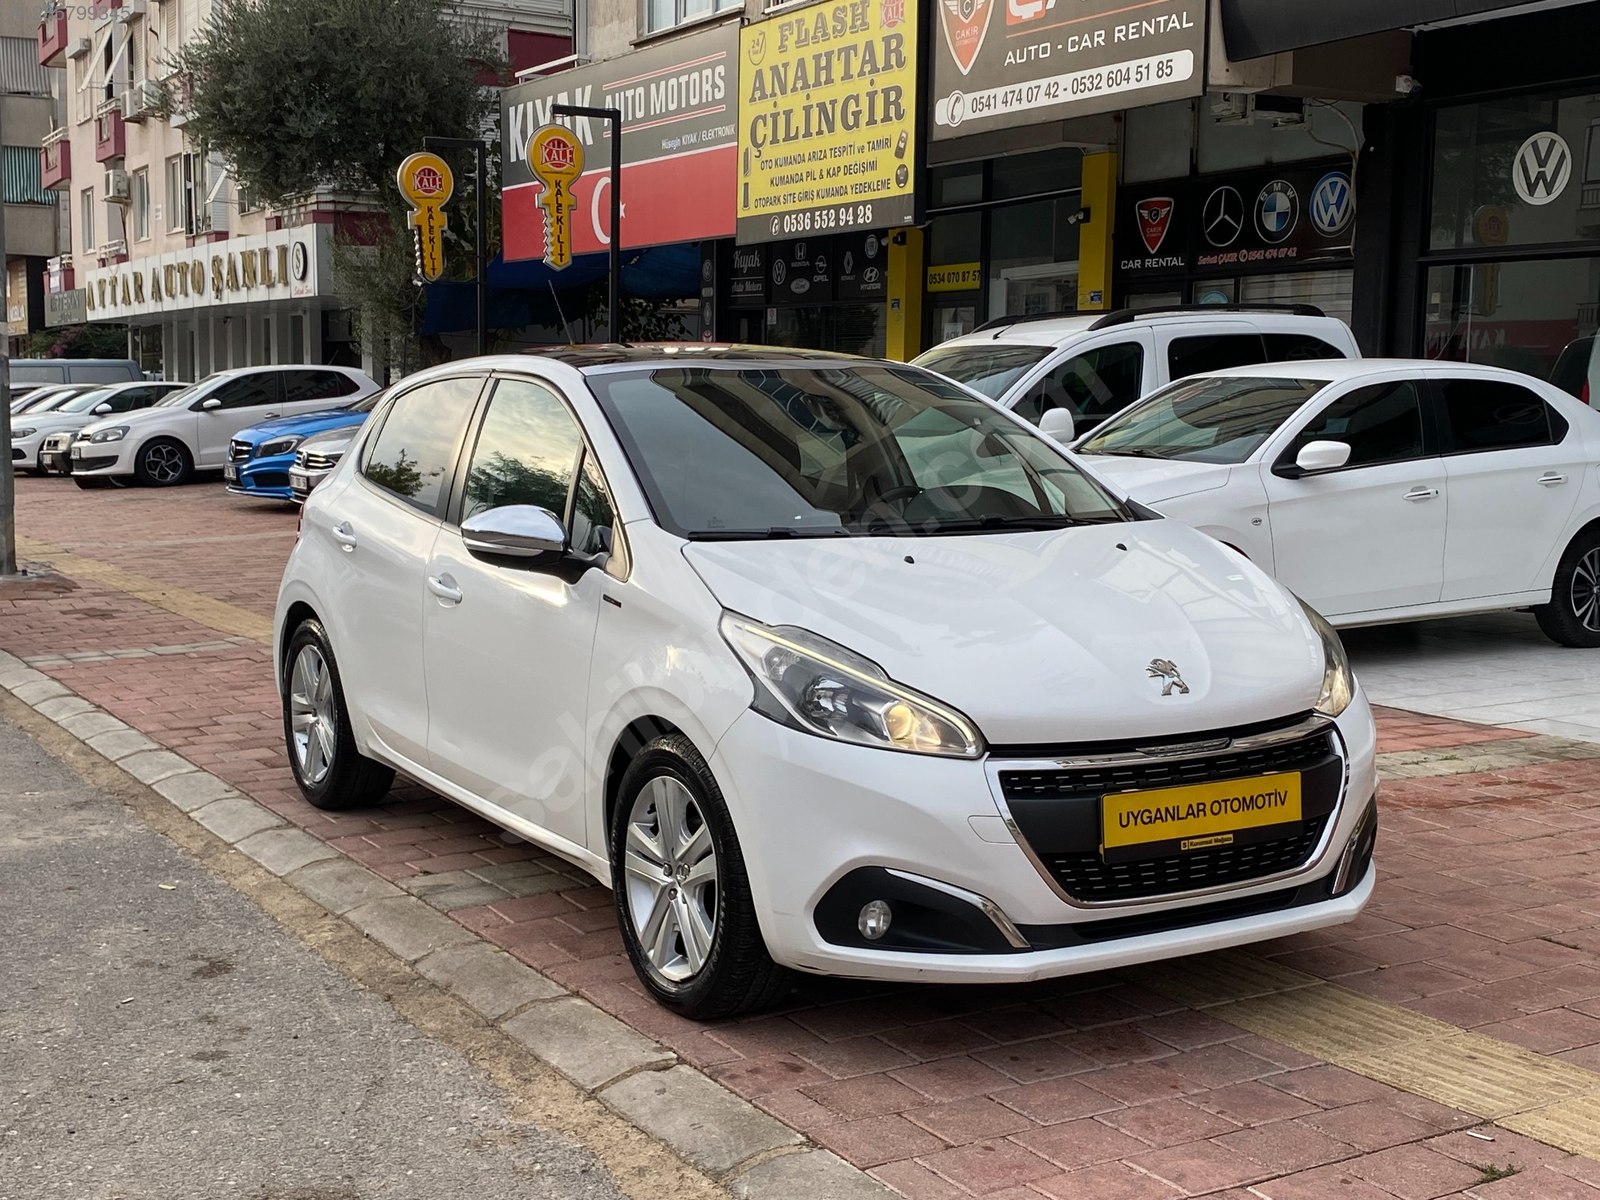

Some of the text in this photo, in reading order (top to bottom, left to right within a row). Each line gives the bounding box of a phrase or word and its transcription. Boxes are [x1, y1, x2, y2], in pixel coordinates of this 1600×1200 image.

[778, 0, 870, 53] FLASH
[881, 4, 905, 25] KALE
[1004, 42, 1051, 66] AUTO
[1067, 29, 1106, 53] CAR
[1114, 11, 1194, 42] RENTAL
[749, 32, 907, 103] ANAHTAR
[971, 93, 998, 113] 0541
[1001, 89, 1023, 107] 474
[1026, 85, 1041, 103] 07
[1044, 81, 1060, 99] 42
[1071, 73, 1103, 96] 0532
[1106, 67, 1132, 89] 604
[1135, 64, 1151, 83] 51
[1156, 59, 1174, 79] 85
[603, 86, 645, 127] AUTO
[650, 64, 725, 116] MOTORS
[749, 78, 906, 158] ÇİLİNGİR
[542, 148, 575, 167] KALE
[760, 159, 773, 171] OTO
[774, 155, 806, 169] KUMANDA
[807, 149, 828, 162] ARIZA
[857, 145, 865, 154] ve
[866, 134, 892, 152] TAMİRİ
[413, 173, 443, 192] KALE
[754, 195, 782, 209] OTOPARK
[816, 184, 848, 200] KUMANDA
[850, 178, 891, 195] YEDEKLEME
[770, 172, 804, 188] KUMANDA
[805, 168, 817, 182] PİL
[818, 170, 824, 180] &
[826, 166, 842, 178] KAP
[783, 204, 873, 233] 0536 552 94 28
[87, 271, 145, 311] AYTAR
[151, 258, 205, 303] AUTO
[211, 243, 289, 300] ŞANLI
[928, 269, 981, 285] 0534 070 87 57
[1120, 256, 1185, 270] CAR RENTAL
[1118, 788, 1288, 829] UYGANLAR OTOMOTİV
